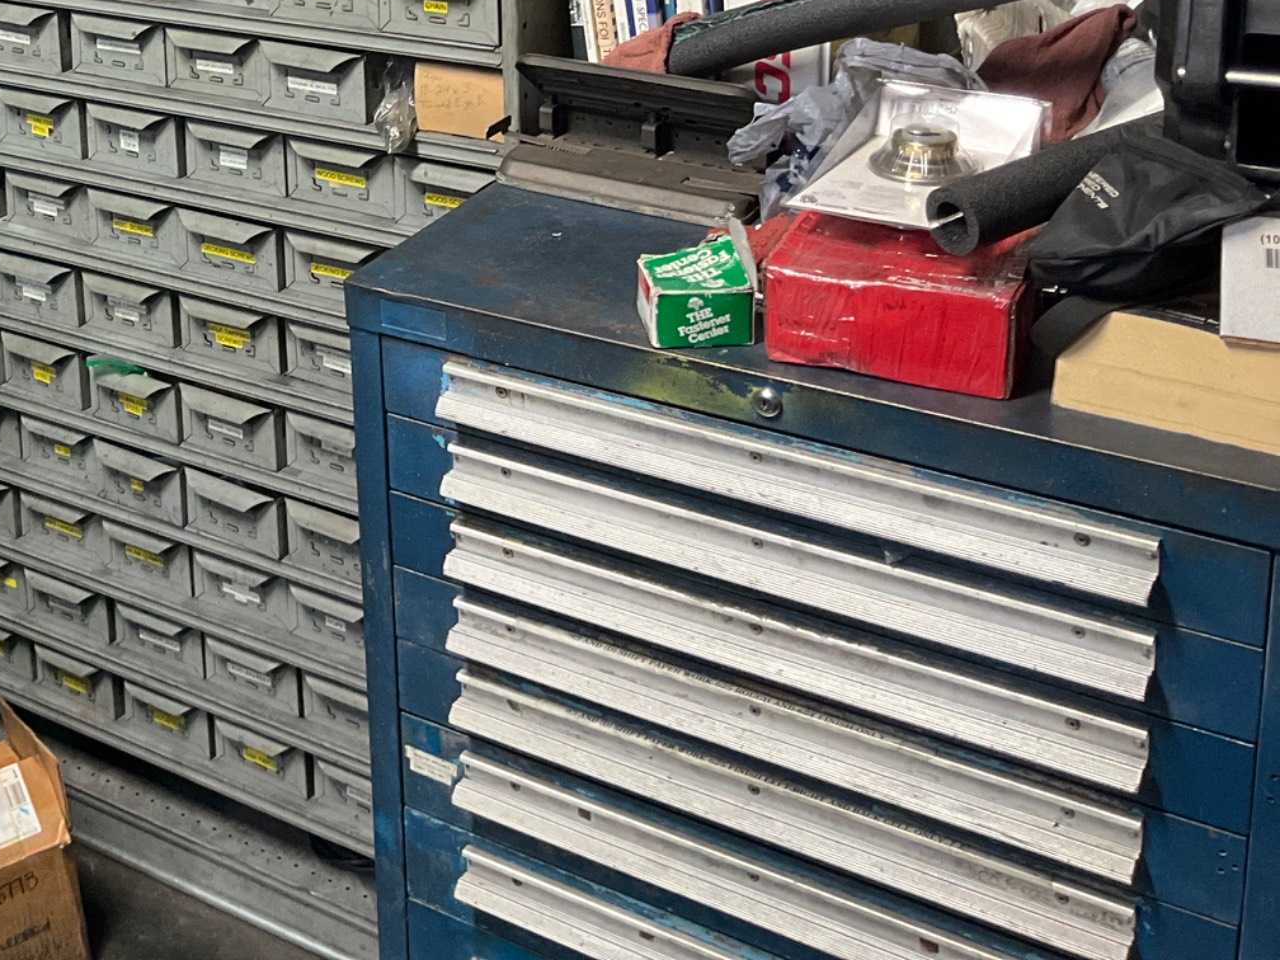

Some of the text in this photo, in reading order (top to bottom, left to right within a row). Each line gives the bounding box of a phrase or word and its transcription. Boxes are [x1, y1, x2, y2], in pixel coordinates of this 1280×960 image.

[686, 306, 714, 323] THE
[677, 313, 731, 337] Fastener
[688, 325, 730, 343] Center
